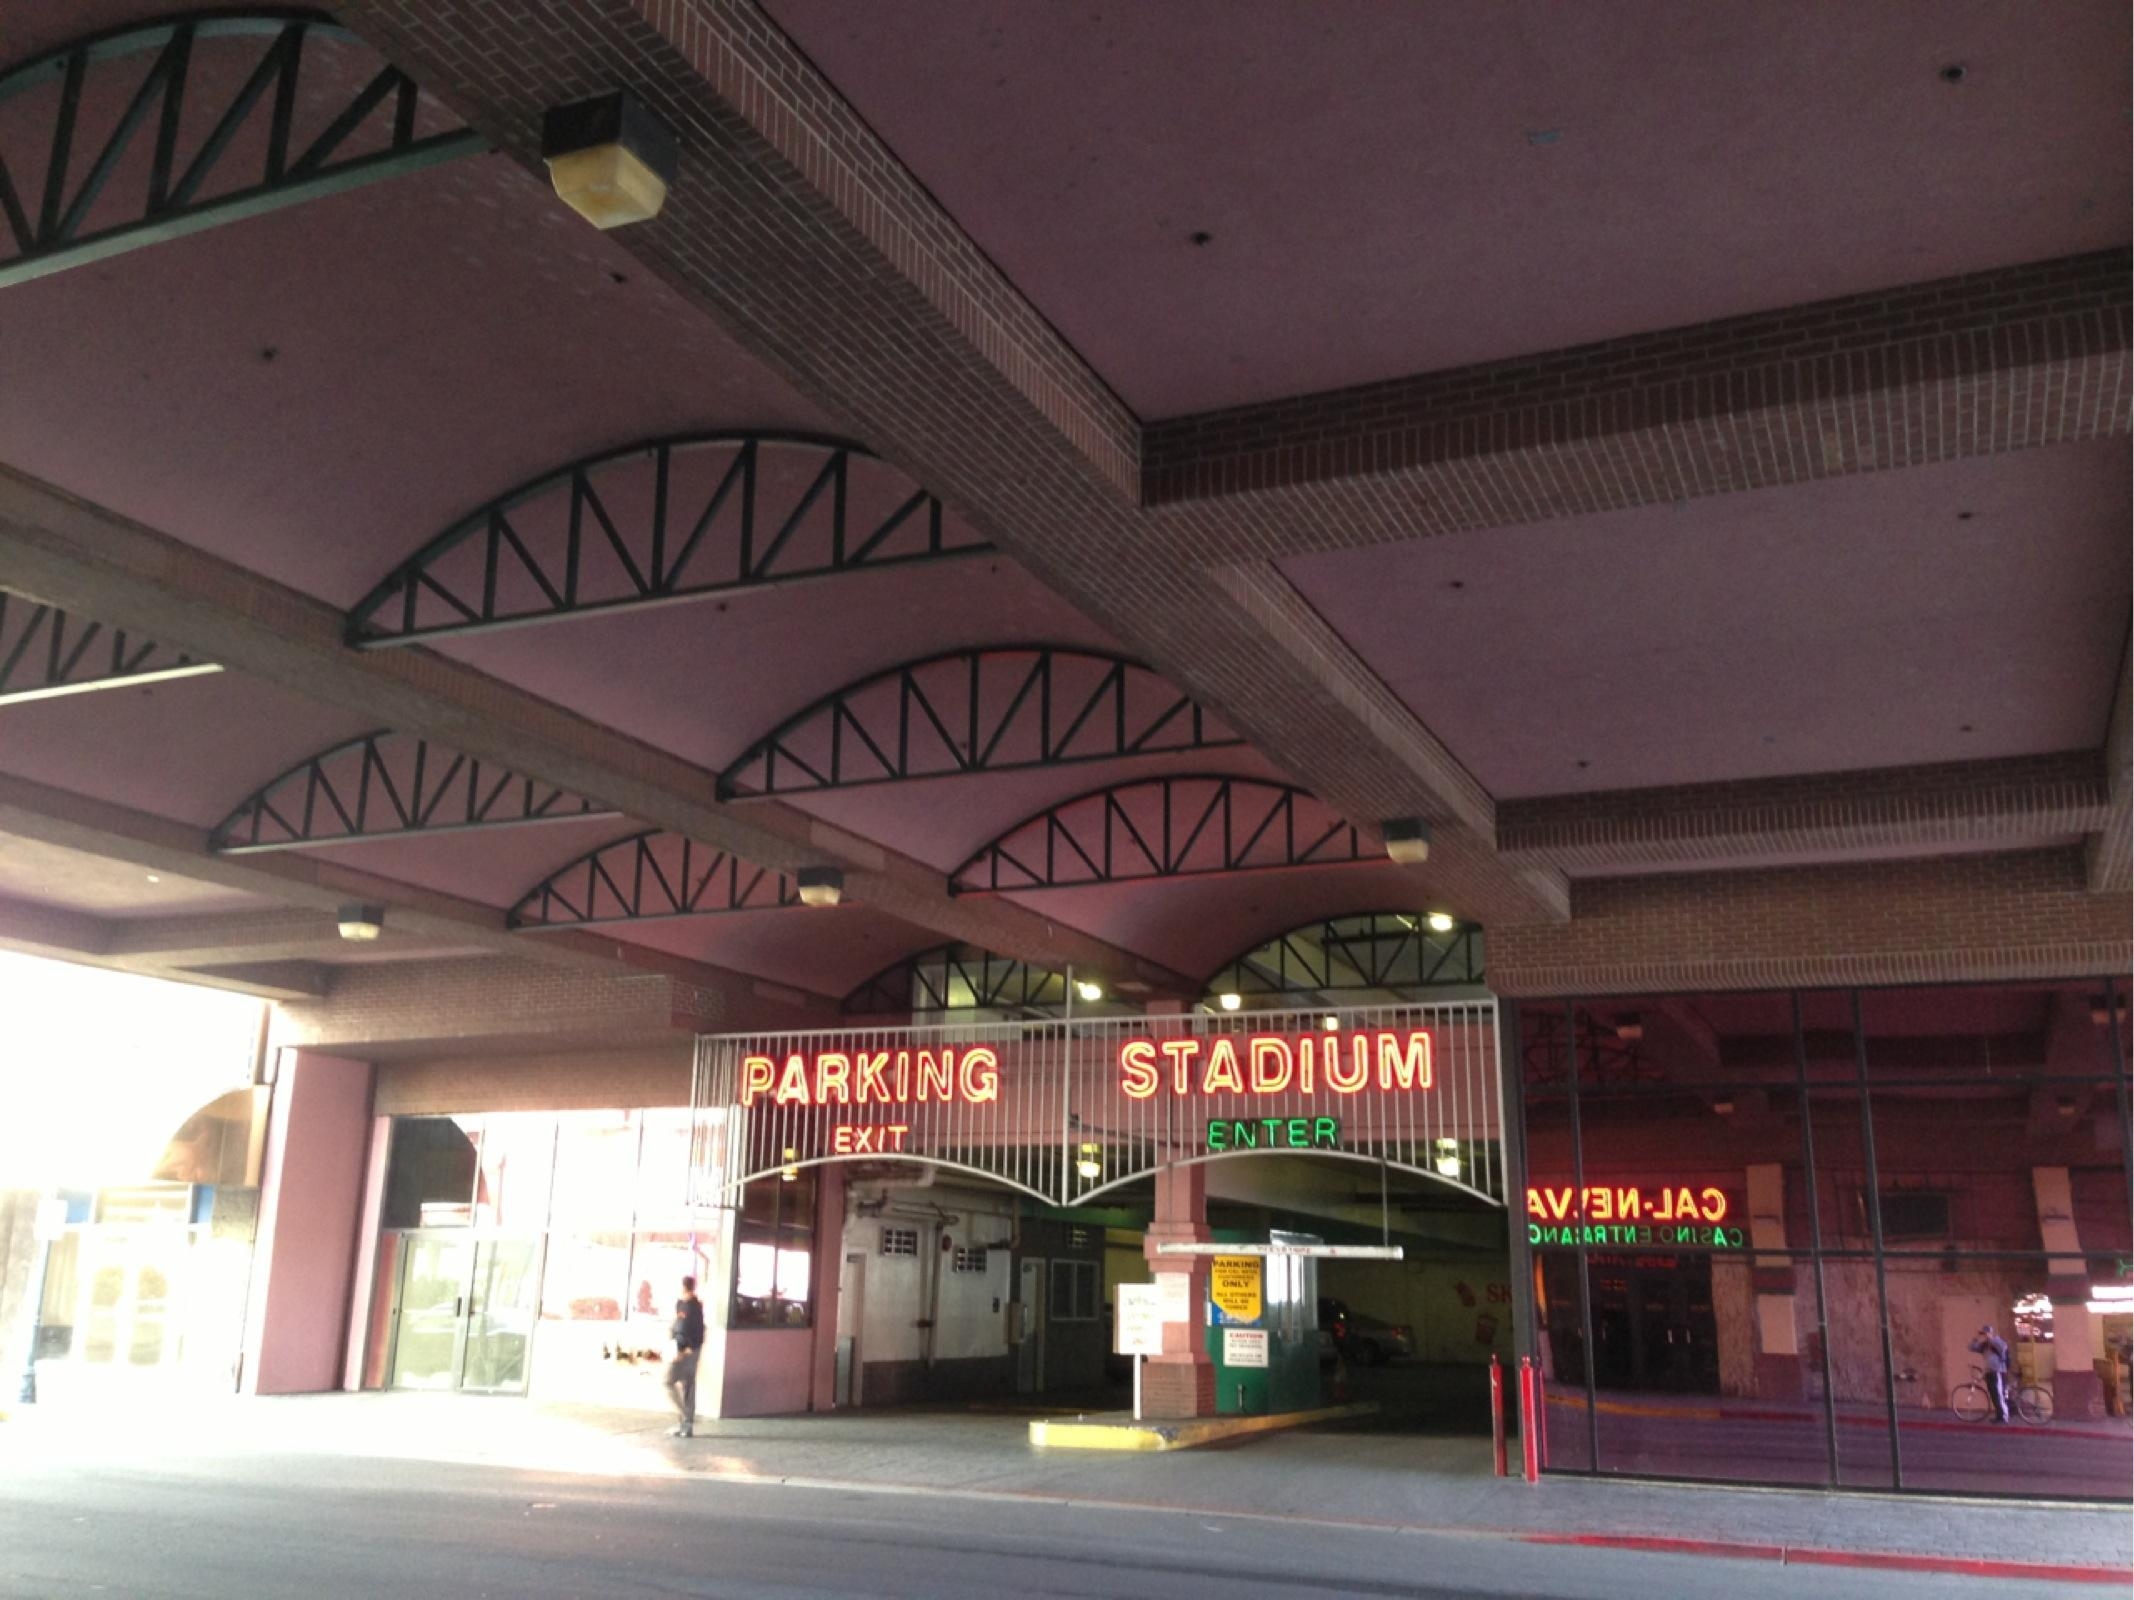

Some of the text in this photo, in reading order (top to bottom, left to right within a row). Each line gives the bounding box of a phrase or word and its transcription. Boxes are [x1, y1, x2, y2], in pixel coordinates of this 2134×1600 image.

[742, 1048, 998, 1106] PARKING
[1121, 1032, 1433, 1098] STADIUM
[834, 1126, 908, 1153] EXIT
[1208, 1117, 1337, 1149] ENTER
[1212, 1260, 1260, 1269] PARKING
[1222, 1280, 1249, 1288] ONLY
